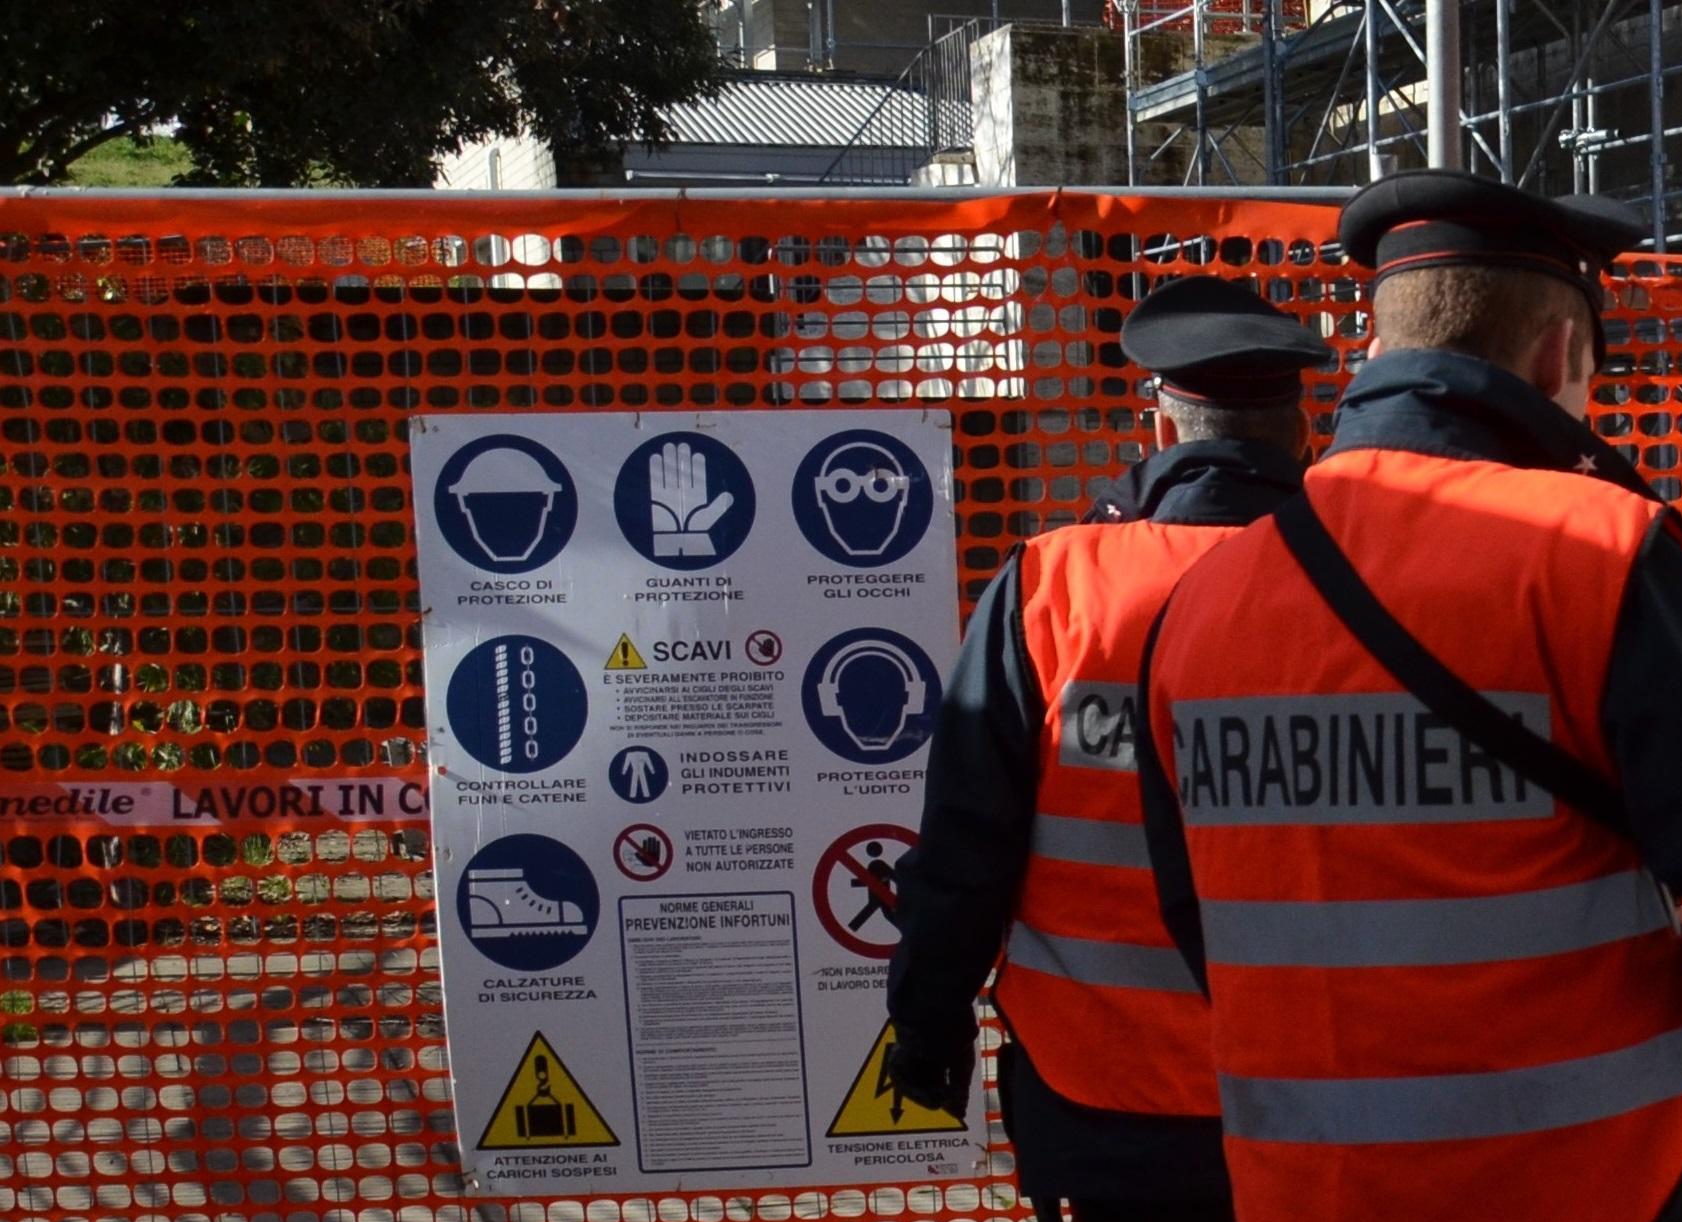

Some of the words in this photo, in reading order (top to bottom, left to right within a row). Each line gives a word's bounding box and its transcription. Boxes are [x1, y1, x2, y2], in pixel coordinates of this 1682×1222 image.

[470, 579, 531, 591] CASCO
[536, 579, 553, 590] DI
[645, 577, 710, 588] GUANTI
[715, 576, 732, 587] DI
[807, 573, 926, 585] PROTEGGERE
[458, 593, 567, 606] PROTEZIONE
[634, 590, 744, 602] PROTEZIONE
[823, 588, 851, 599] GLI
[857, 587, 911, 598] OCCHI
[653, 640, 732, 662] SCAVI
[616, 671, 716, 684] SEVERAMENTE
[720, 670, 785, 682] PROIBITO
[623, 686, 679, 696] AVVICINARSI
[681, 685, 691, 694] AI
[693, 685, 716, 694] CIGLI
[718, 684, 745, 693] DEGLI
[747, 684, 774, 692] SCAVI
[624, 704, 668, 713] SOSTARE
[670, 703, 708, 712] PRESSO
[711, 702, 723, 711] LE
[726, 702, 774, 711] SCARPATE
[624, 712, 680, 722] DEPOSITARE
[683, 711, 732, 721] MATERIALE
[735, 711, 749, 720] SUI
[751, 711, 775, 720] CIGLI
[680, 750, 789, 763] INDOSSARE
[681, 767, 705, 779] GLI
[709, 766, 790, 778] INDUMENTI
[817, 769, 926, 783] PROTEGGER
[456, 778, 587, 791] CONTROLLARE
[682, 781, 791, 795] PROTETTIVI
[843, 783, 911, 795] L'UDITO
[172, 782, 323, 820] LAVORI
[338, 784, 384, 817] IN
[458, 794, 498, 805] FUNI
[503, 793, 513, 804] E
[519, 792, 587, 804] CATENE
[685, 829, 728, 841] VIETATO
[730, 827, 793, 840] L'INGRESSO
[685, 845, 692, 857] A
[694, 845, 727, 856] TUTTE
[730, 844, 742, 855] LE
[746, 843, 794, 855] PERSONE
[686, 860, 711, 872] NON
[715, 858, 795, 871] AUTORIZZATE
[659, 902, 699, 914] NORME
[701, 900, 755, 913] GENERALI
[625, 915, 717, 931] PREVENZIONE
[720, 913, 791, 928] INFORTUNI
[820, 967, 842, 977] NON
[483, 976, 586, 990] CALZATURE
[817, 981, 828, 991] DI
[830, 980, 870, 991] LAVORO
[478, 993, 495, 1003] DI
[499, 990, 598, 1003] SICUREZZA
[827, 1141, 894, 1154] TENSIONE
[897, 1138, 970, 1151] ELETTRICA
[494, 1154, 588, 1166] ATTENZIONE
[592, 1153, 607, 1164] AI
[854, 1152, 945, 1167] PERICOLOSA
[486, 1168, 547, 1180] CARICHI
[551, 1166, 617, 1178] SOSPESI
